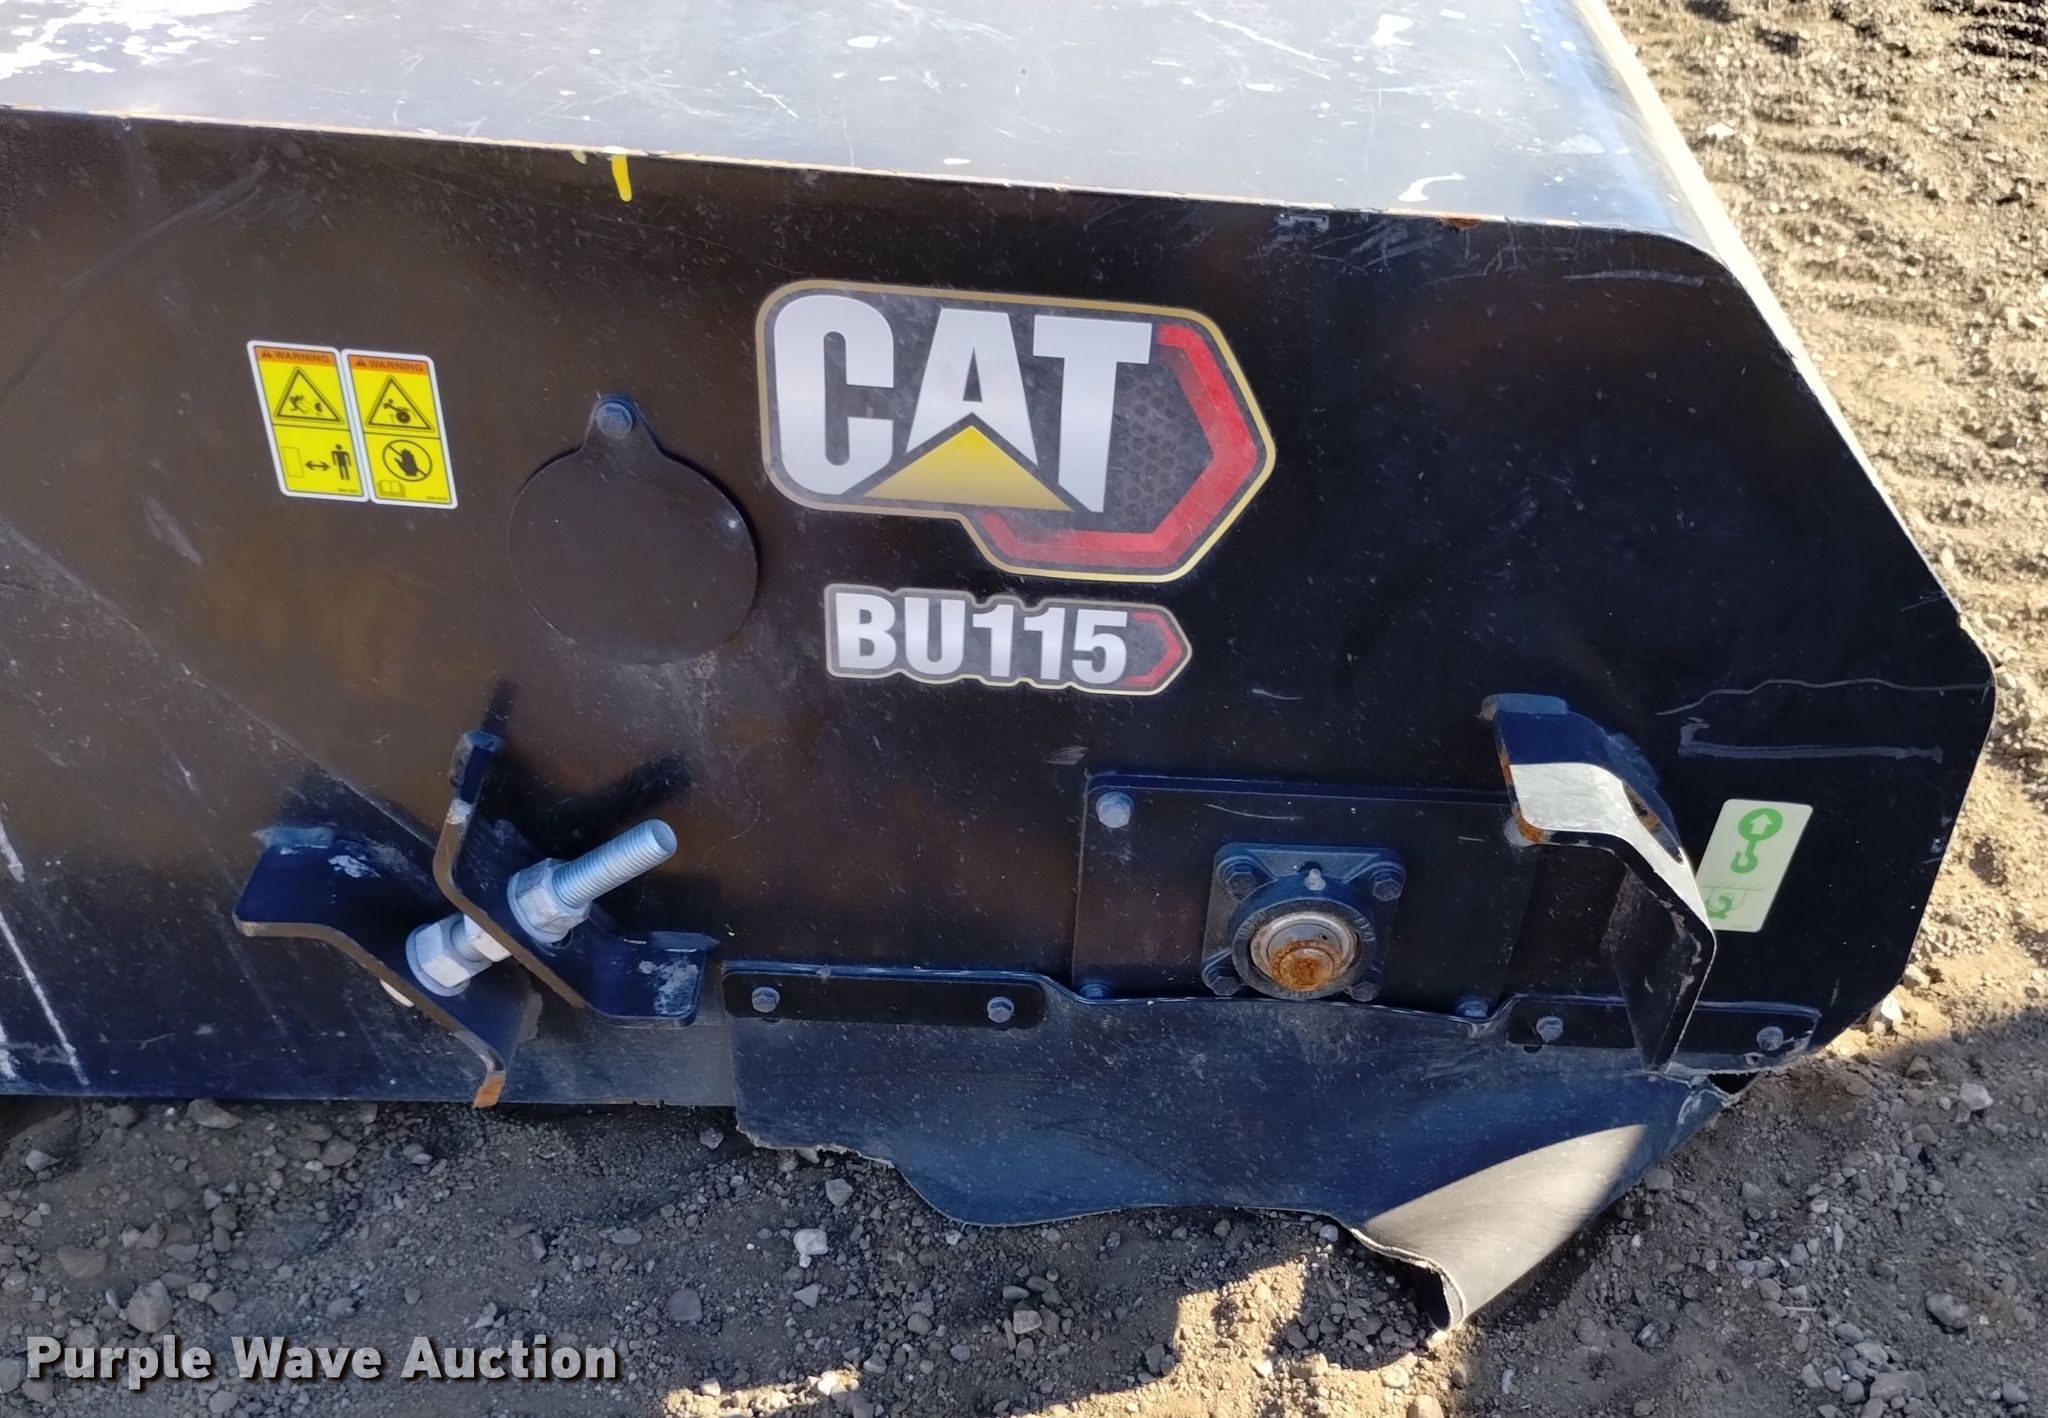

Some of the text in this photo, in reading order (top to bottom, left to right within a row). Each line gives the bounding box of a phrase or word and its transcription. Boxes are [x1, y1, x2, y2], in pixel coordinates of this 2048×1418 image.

[275, 351, 330, 363] WARNING
[369, 360, 424, 373] WARNING
[773, 294, 1152, 514] CAT
[834, 592, 1128, 684] BU115
